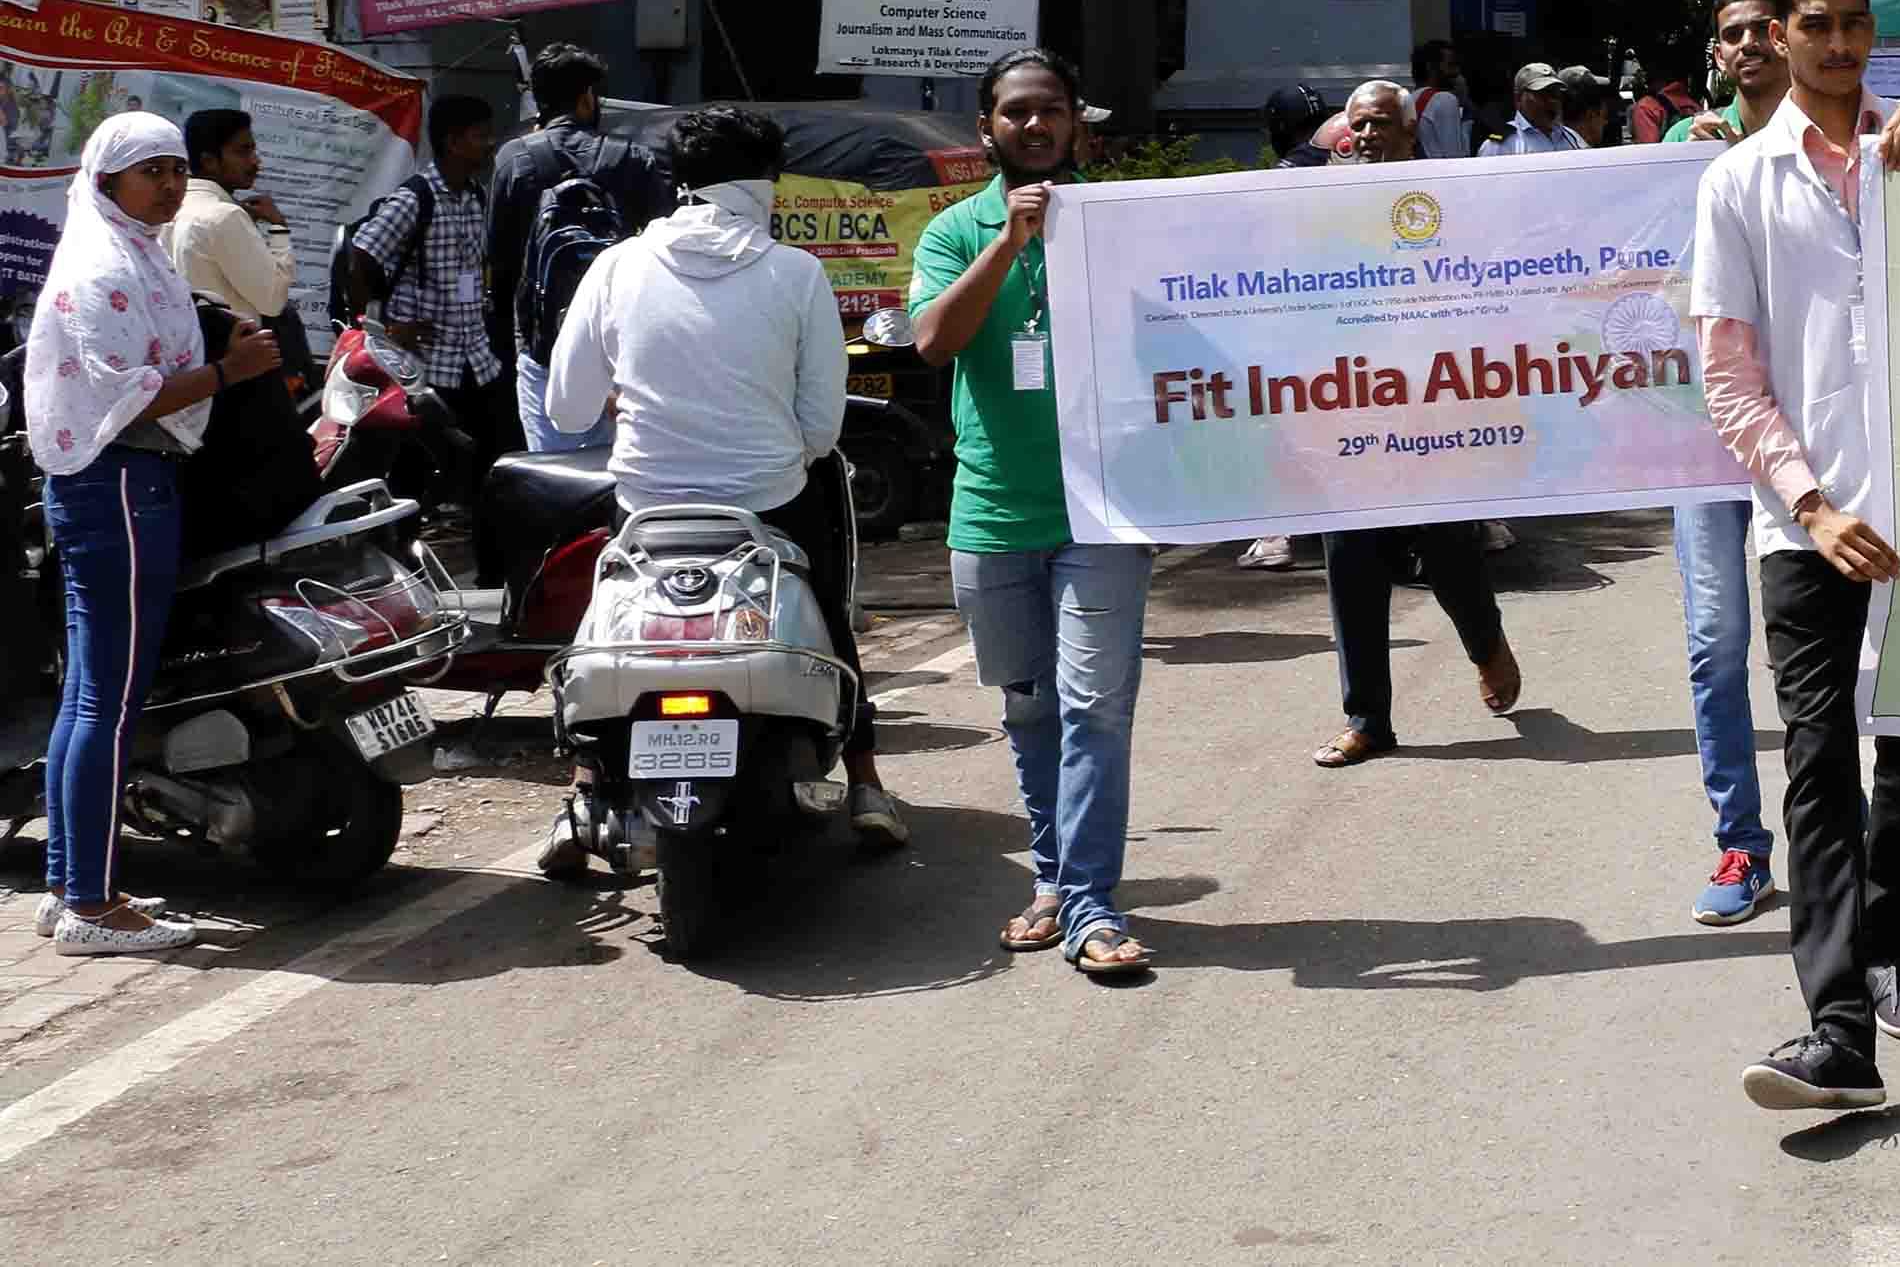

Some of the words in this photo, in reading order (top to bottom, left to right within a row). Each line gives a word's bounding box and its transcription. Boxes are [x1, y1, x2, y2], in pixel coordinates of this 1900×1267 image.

[880, 5, 939, 20] Computer
[943, 6, 987, 20] Science
[837, 22, 893, 37] Journalism
[895, 24, 915, 38] and
[918, 26, 944, 38] Mass
[946, 26, 1027, 41] Communication
[59, 11, 97, 39] the
[104, 16, 144, 48] Art
[189, 29, 272, 70] Science
[280, 50, 305, 83] of
[954, 47, 989, 58] Center
[848, 196, 895, 209] Science
[769, 213, 818, 241] BCS
[839, 213, 890, 241] BCA
[1160, 272, 1229, 302] Tilak
[1237, 261, 1416, 297] Maharashtra
[1423, 248, 1590, 288] Vidyapeeth,
[1600, 246, 1676, 271] Pune.
[1336, 314, 1386, 326] Accredited
[1387, 313, 1399, 325] by
[1401, 309, 1428, 320] NAAC
[1430, 309, 1451, 319] with
[1153, 367, 1235, 424] Fit
[1247, 355, 1408, 416] India
[1424, 341, 1691, 407] Abhiyan
[1338, 433, 1379, 457] 29th
[1385, 429, 1465, 456] August
[1469, 424, 1525, 448] 2019
